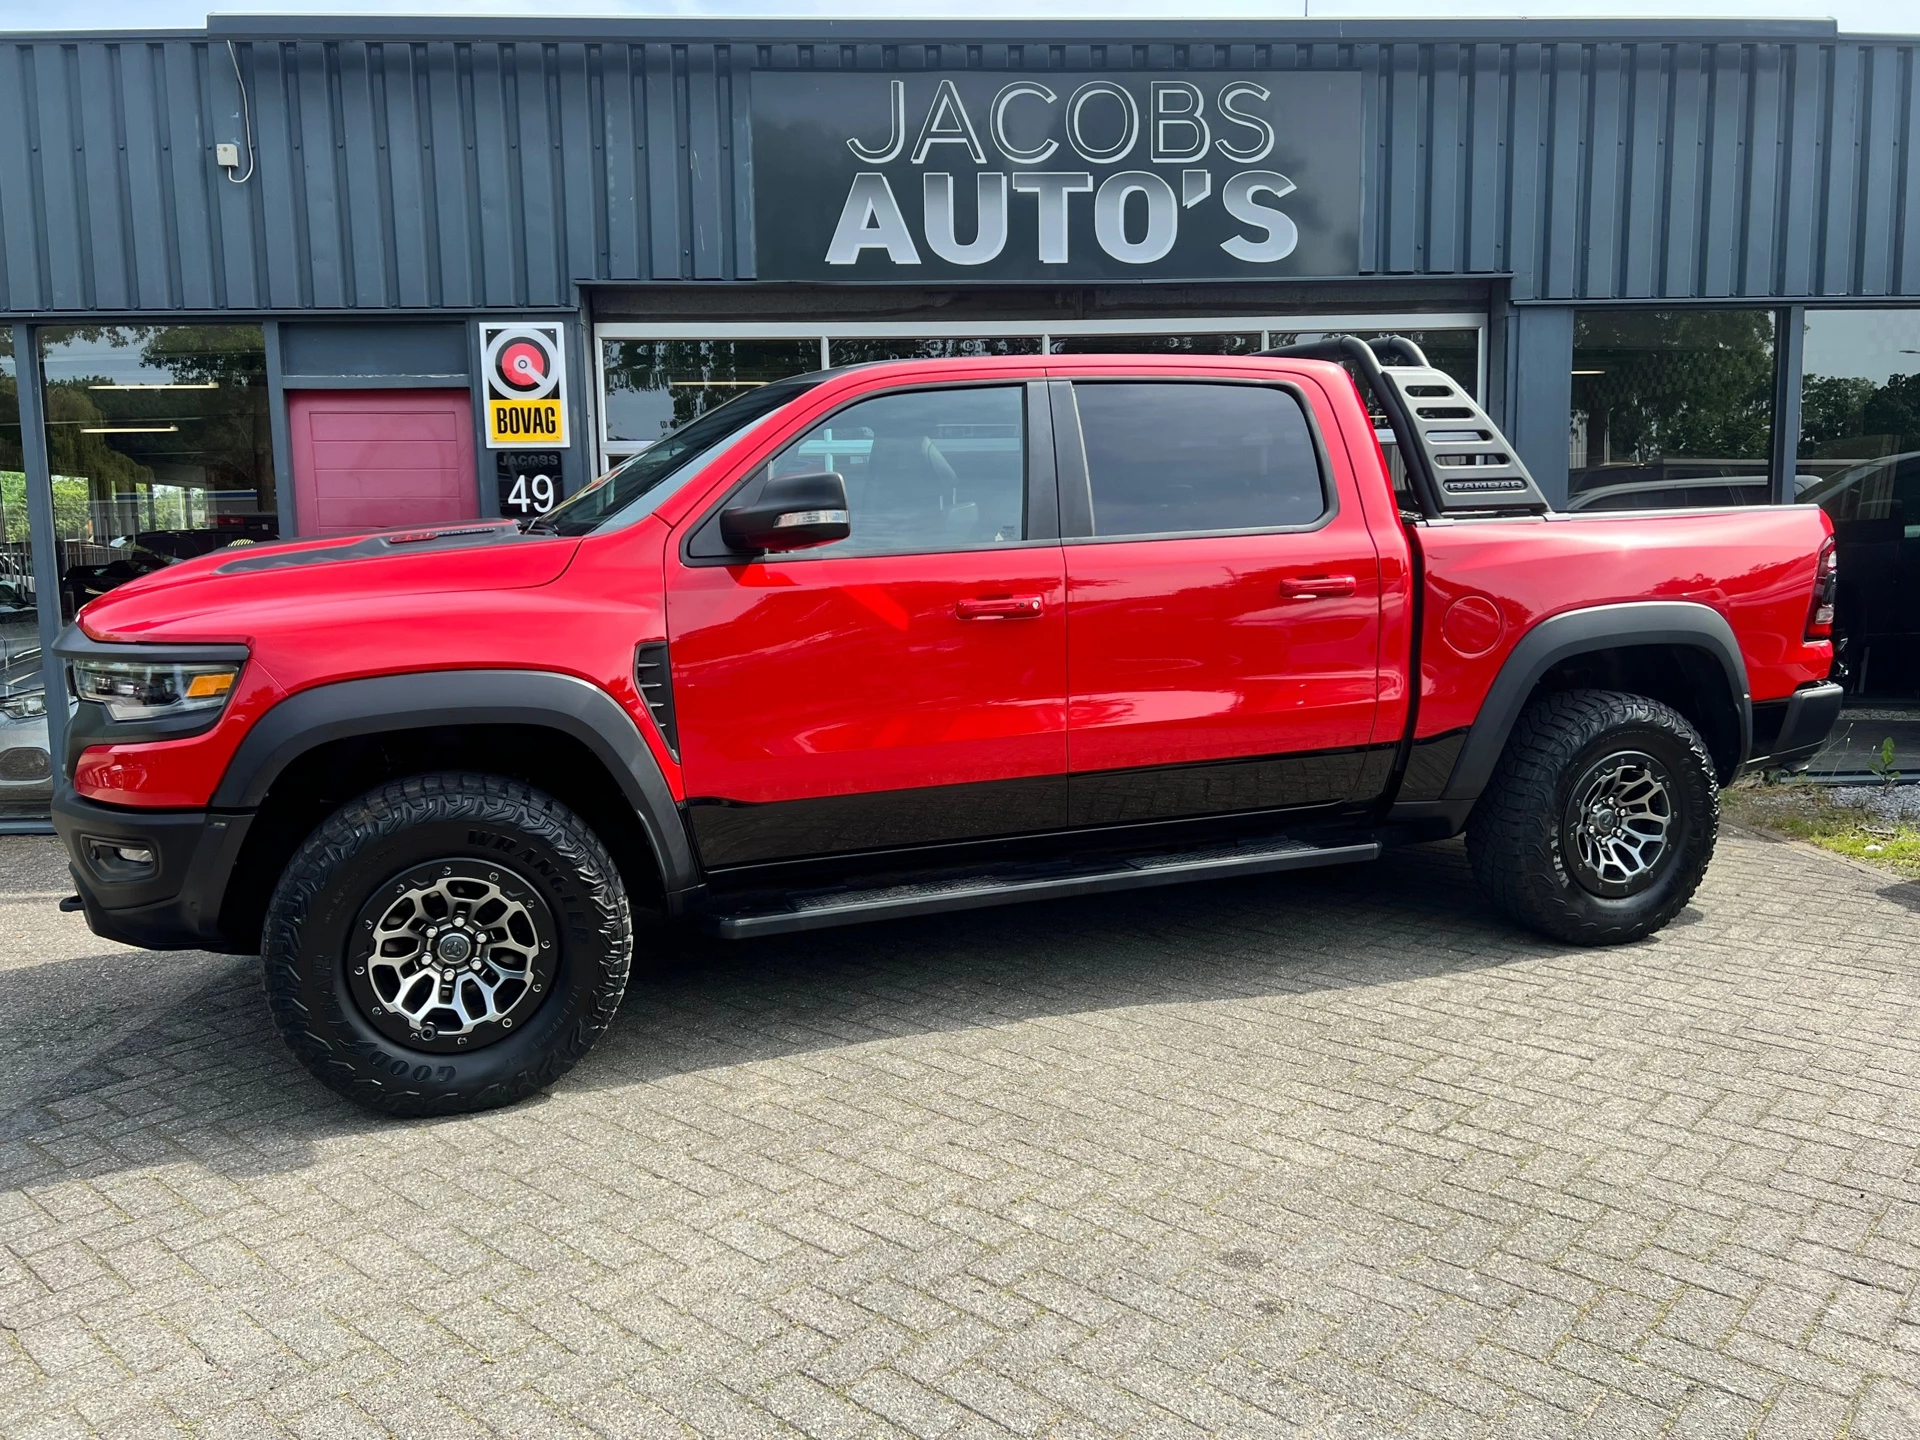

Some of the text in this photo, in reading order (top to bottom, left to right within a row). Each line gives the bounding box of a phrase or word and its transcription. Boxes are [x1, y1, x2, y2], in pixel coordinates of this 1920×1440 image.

[846, 80, 1275, 164] JACOBS
[824, 170, 1298, 265] AUTO'S
[496, 406, 556, 434] BOVAG
[499, 454, 558, 466] JACOBS
[507, 474, 554, 513] 49
[1448, 480, 1524, 491] RAMBAR
[467, 828, 589, 946] WRANGLER
